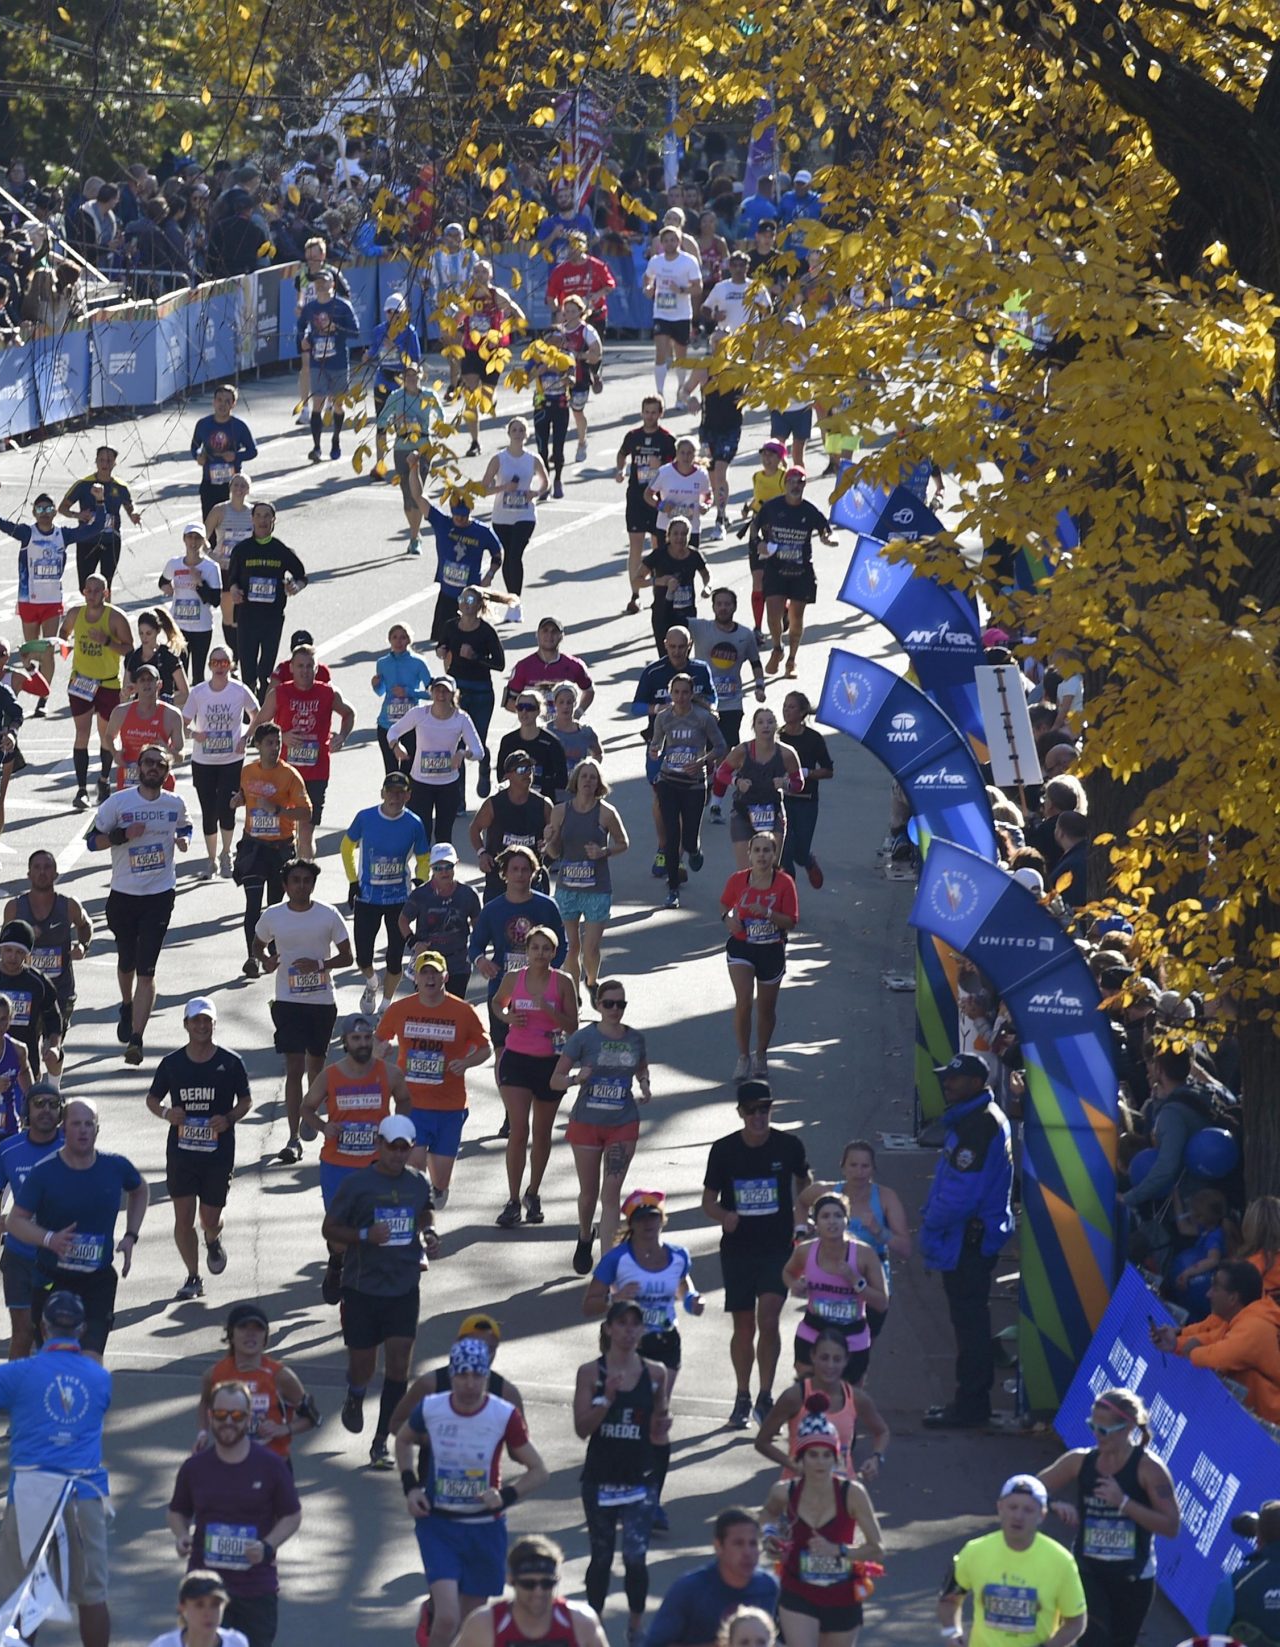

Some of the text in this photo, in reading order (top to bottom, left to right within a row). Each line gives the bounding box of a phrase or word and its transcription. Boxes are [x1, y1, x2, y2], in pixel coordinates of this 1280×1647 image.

[904, 627, 976, 646] NYRR
[207, 703, 230, 714] NEW
[205, 714, 233, 724] YORK
[208, 723, 231, 732] CITY
[887, 732, 918, 742] TATA
[134, 810, 167, 822] EDDIE
[979, 936, 1036, 948] UNITED
[293, 974, 319, 986] 13626
[406, 1025, 456, 1038] FRED'S TEAM
[411, 1059, 438, 1073] 33642
[180, 1088, 215, 1101] BERNI
[185, 1102, 210, 1112] MÉXICO
[363, 1096, 381, 1106] TEAM
[183, 1126, 213, 1141] 26449
[1108, 1337, 1134, 1381] UNITED
[601, 1424, 642, 1439] FREDEL
[1191, 1451, 1224, 1501] UNITED
